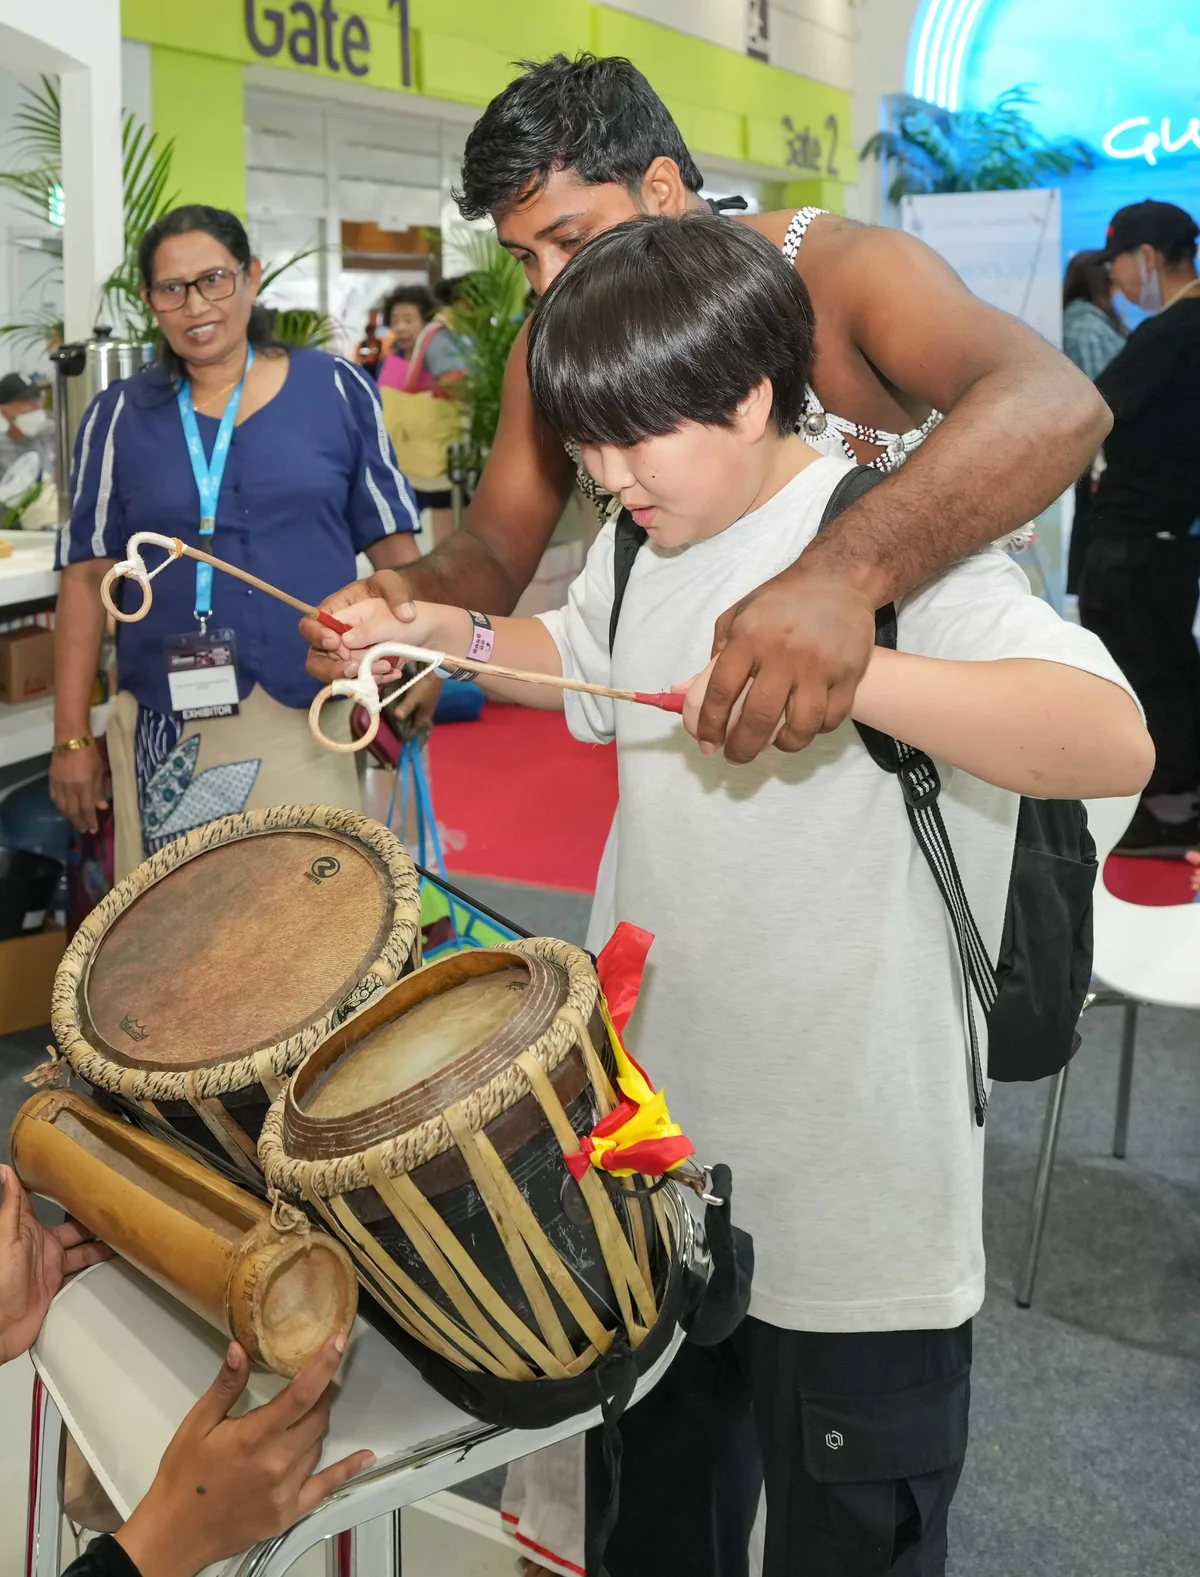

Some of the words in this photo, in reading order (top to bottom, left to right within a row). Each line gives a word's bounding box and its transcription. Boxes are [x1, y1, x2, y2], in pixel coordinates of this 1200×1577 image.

[244, 0, 371, 77] Gate
[388, 0, 411, 87] 1
[182, 704, 233, 720] EXHIBITOR
